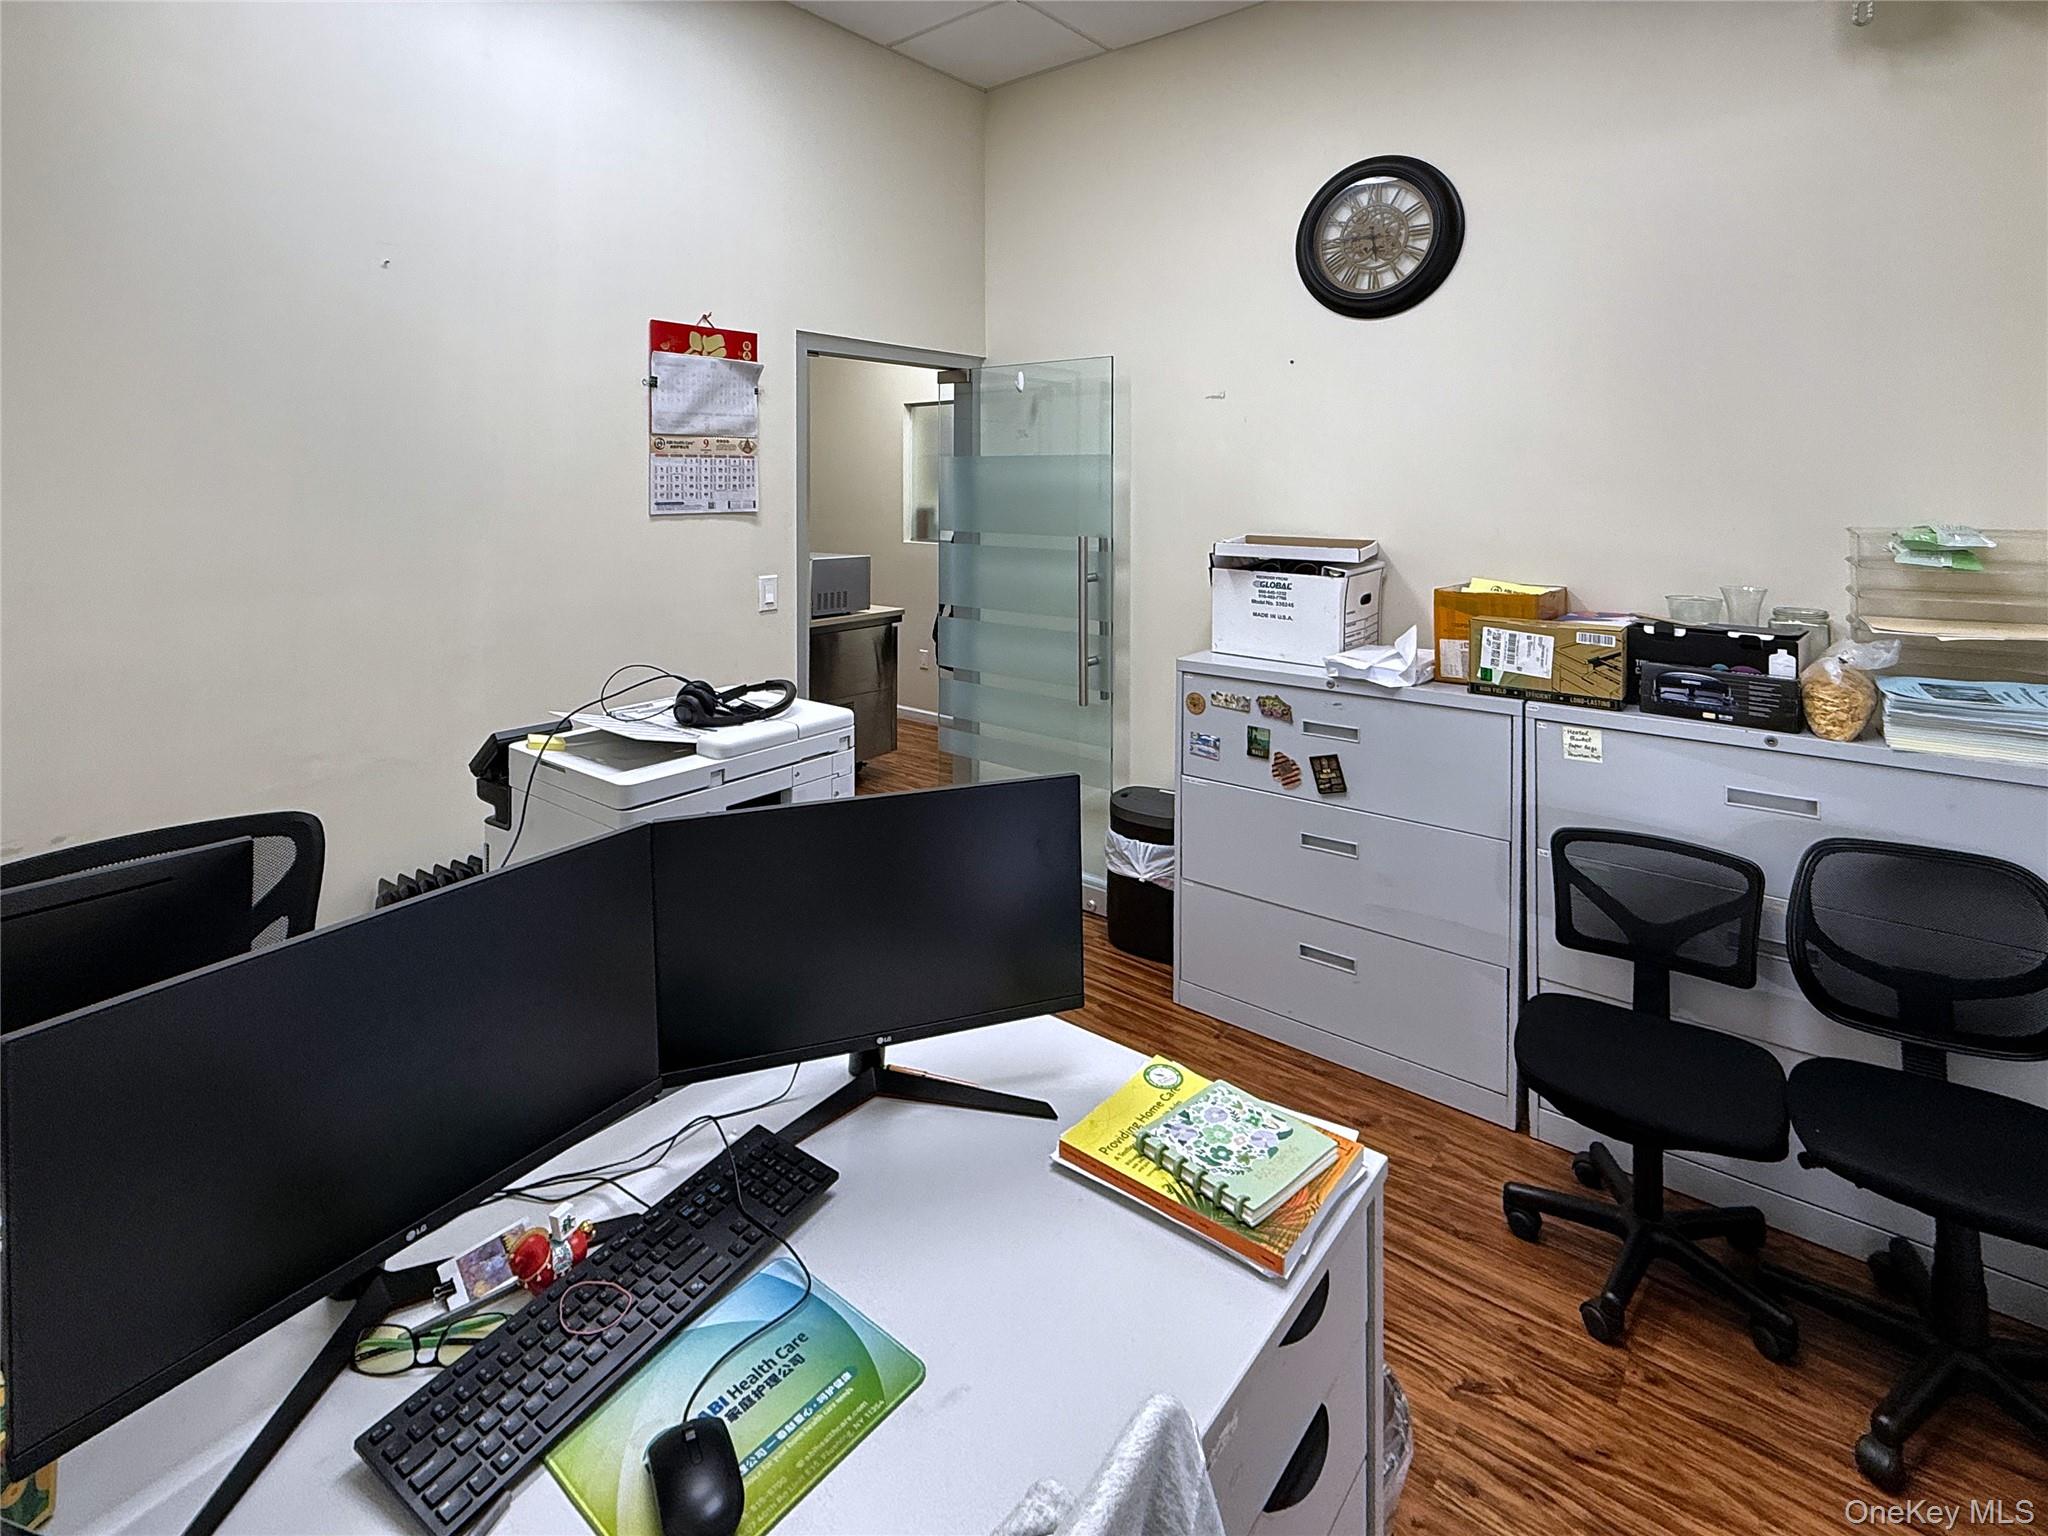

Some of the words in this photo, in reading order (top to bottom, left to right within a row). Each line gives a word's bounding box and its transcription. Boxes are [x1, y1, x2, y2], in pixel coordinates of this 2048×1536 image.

[703, 438, 710, 449] 9
[1258, 581, 1293, 590] GLOBAL
[1525, 690, 1552, 700] EFFICIENT
[1569, 695, 1611, 708] LONG-LASTING
[1098, 1121, 1142, 1155] Providing
[1136, 1101, 1164, 1123] Home
[726, 1357, 778, 1400] Health
[775, 1332, 809, 1359] Care
[724, 1353, 806, 1423] 家庭护理公司
[852, 1416, 865, 1430] NY
[863, 1398, 885, 1419] 11354
